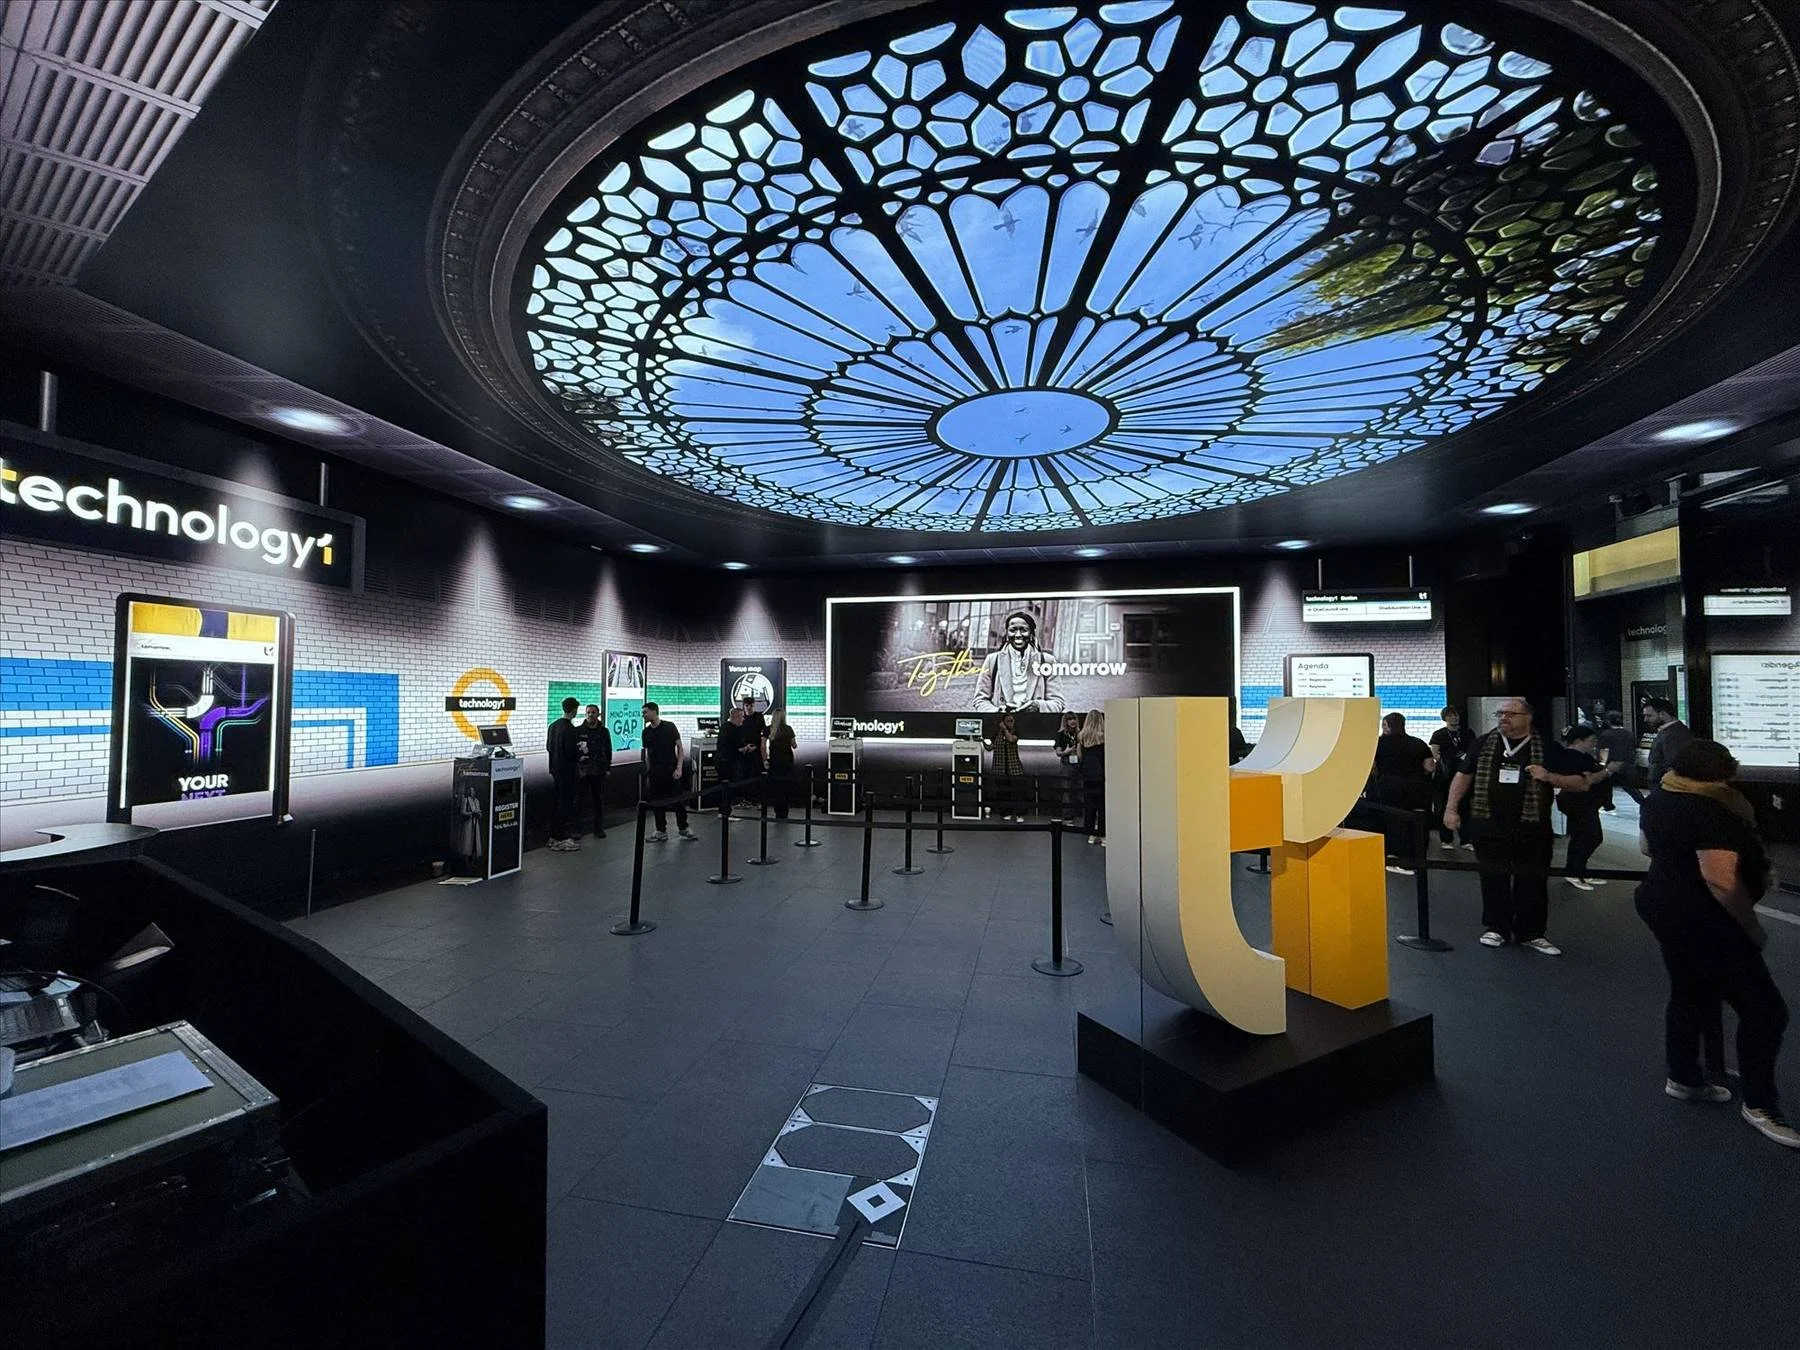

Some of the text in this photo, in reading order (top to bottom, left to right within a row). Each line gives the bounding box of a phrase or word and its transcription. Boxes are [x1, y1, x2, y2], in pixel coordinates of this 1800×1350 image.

[728, 664, 746, 673] Venue
[896, 646, 991, 698] Together
[1031, 661, 1128, 677] tomorrow
[1297, 662, 1329, 671] Agenda
[458, 698, 505, 710] technology1
[613, 719, 638, 736] GAP
[853, 719, 905, 735] hnology1
[178, 774, 229, 792] YOUR
